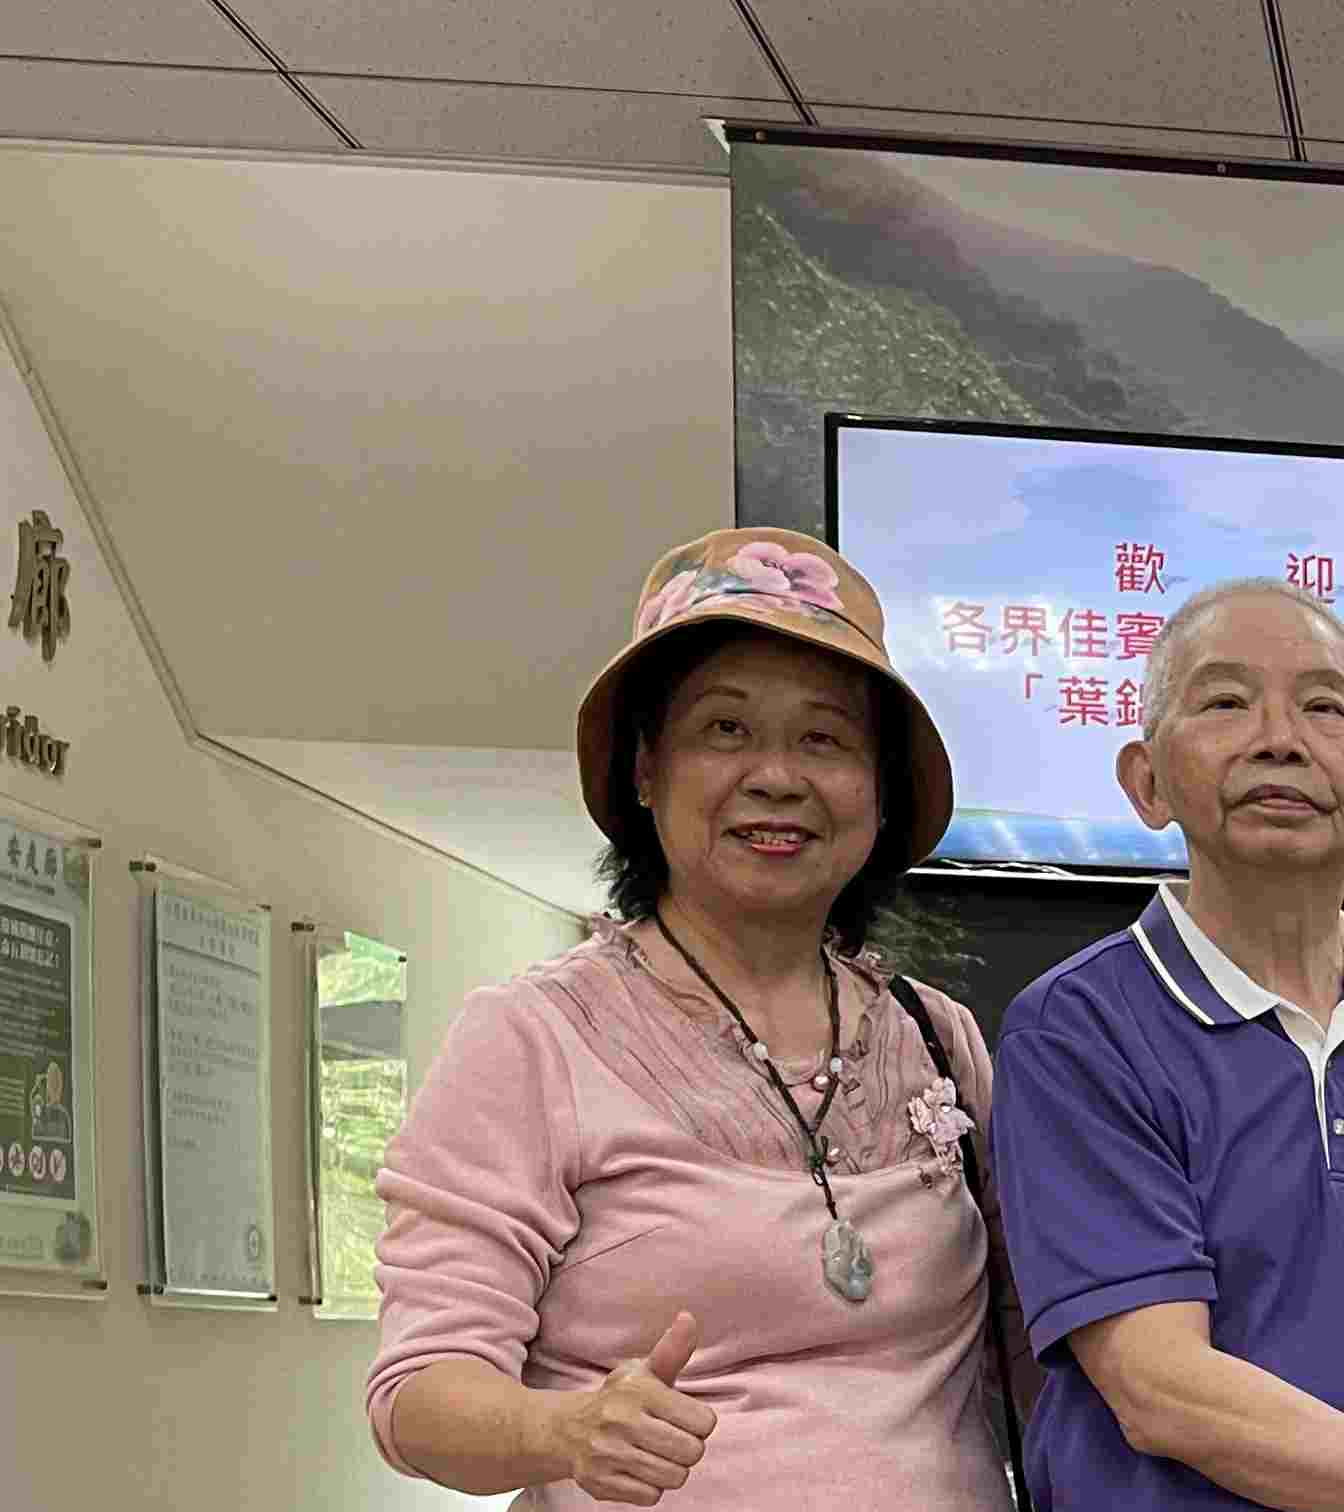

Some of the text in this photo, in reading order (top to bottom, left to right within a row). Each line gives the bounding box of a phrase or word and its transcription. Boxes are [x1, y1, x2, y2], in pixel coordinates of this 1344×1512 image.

[8, 510, 71, 662] 廊
[1115, 543, 1334, 603] 歡 迎
